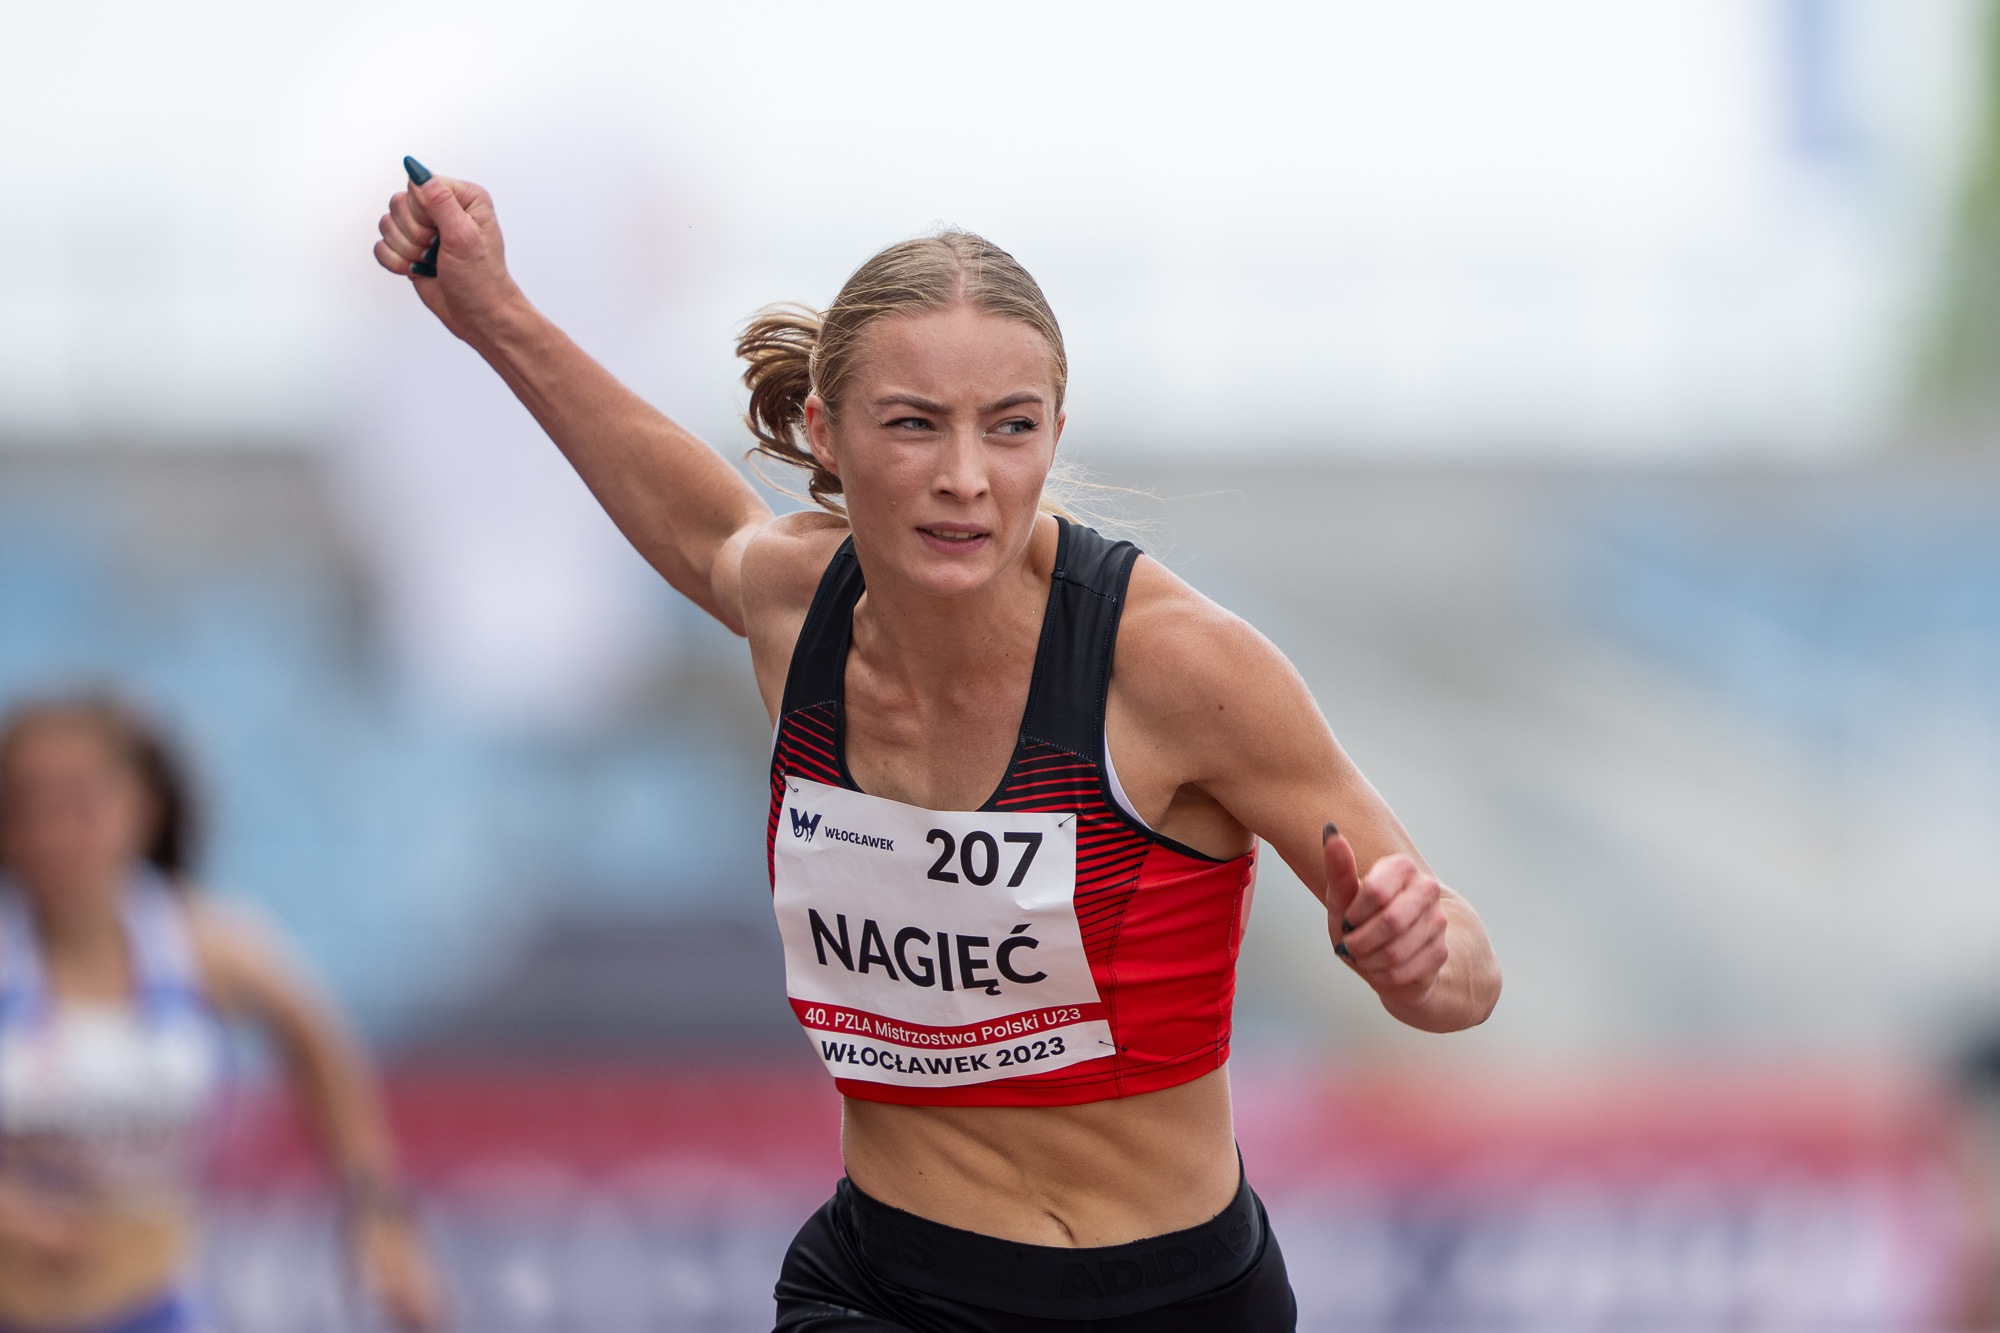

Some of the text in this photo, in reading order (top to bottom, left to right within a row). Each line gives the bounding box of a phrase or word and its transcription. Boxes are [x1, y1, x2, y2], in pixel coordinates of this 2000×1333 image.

[824, 826, 894, 851] WŁOCŁAWEK
[925, 828, 1043, 887] 207
[807, 907, 1048, 996] NAGIĘĆ
[805, 1007, 1082, 1046] 40. PZLA Mistrzostwa Polski U23
[821, 1036, 1066, 1075] WŁOCŁAWEK 2023
[1059, 1213, 1251, 1299] ADIDAS
